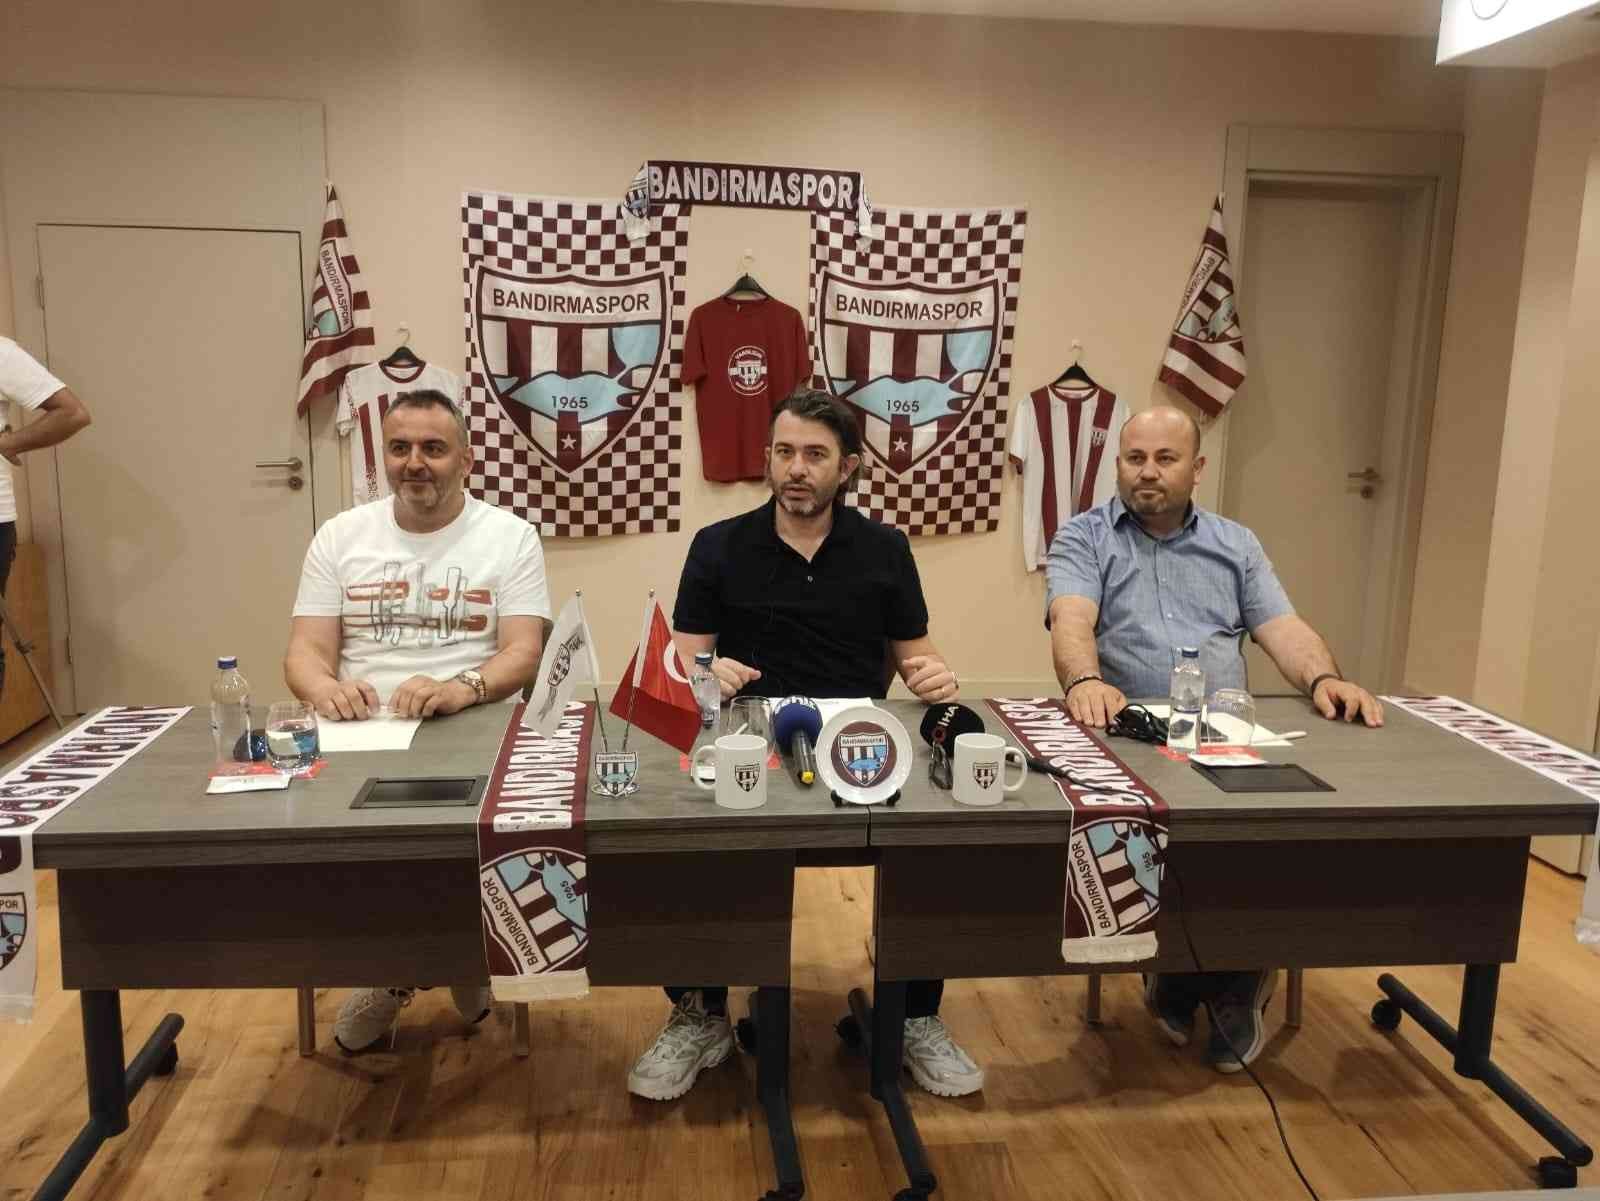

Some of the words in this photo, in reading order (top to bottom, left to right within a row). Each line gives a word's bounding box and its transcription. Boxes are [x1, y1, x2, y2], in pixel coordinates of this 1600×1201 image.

[648, 165, 853, 209] BANDIRMASPOR
[493, 289, 650, 314] BANDIRMASPOR
[837, 294, 983, 321] BANDIRMASPOR
[552, 395, 588, 410] 1965
[886, 399, 920, 413] 1965
[560, 880, 576, 904] 1965
[1072, 840, 1111, 929] BANDIRMASPOR
[482, 877, 538, 966] BANDIRMASPOR
